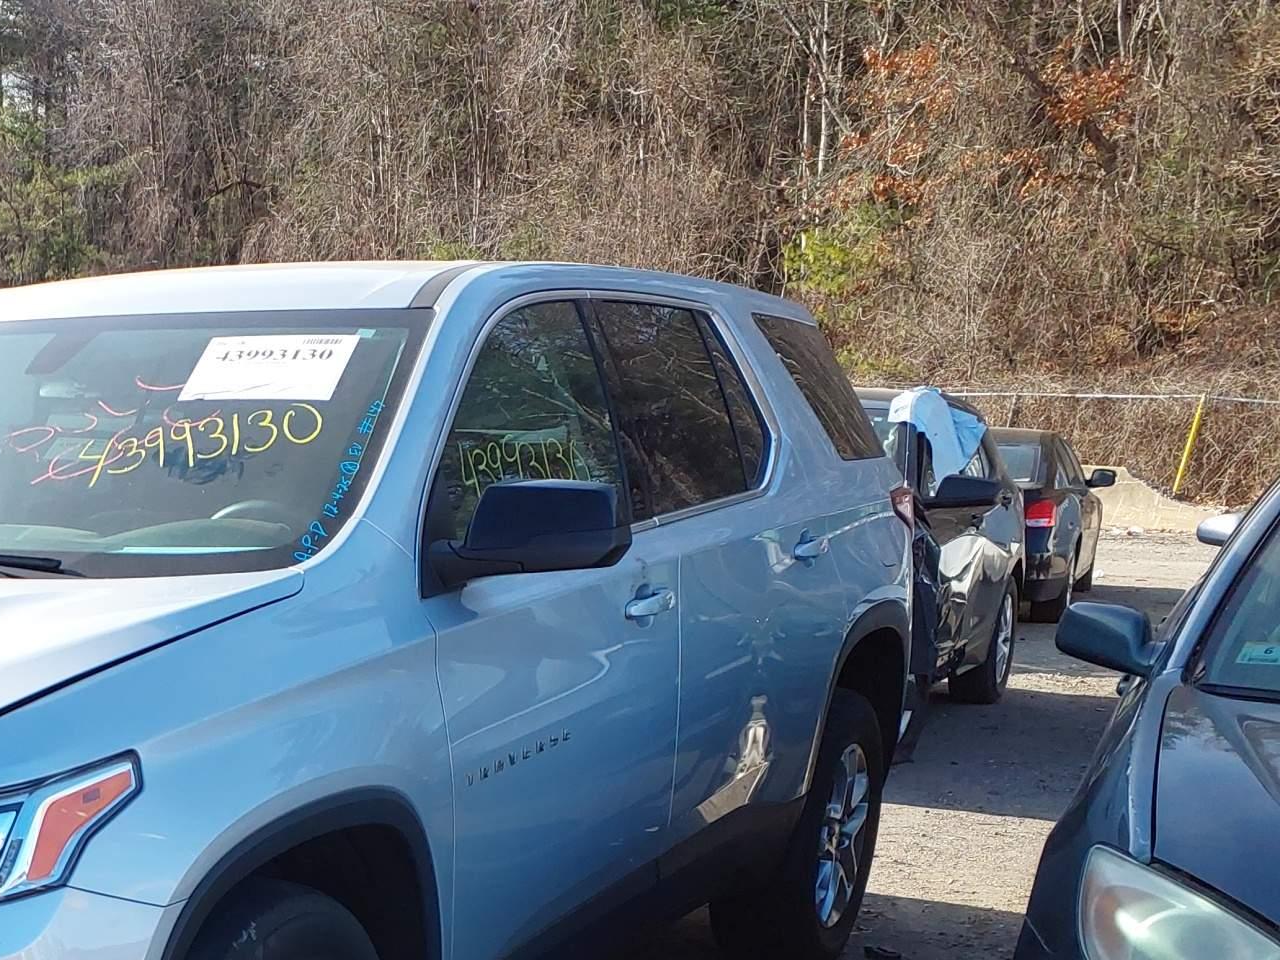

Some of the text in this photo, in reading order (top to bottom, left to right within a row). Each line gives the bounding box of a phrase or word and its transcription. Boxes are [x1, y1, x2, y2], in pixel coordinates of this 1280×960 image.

[215, 348, 334, 361] 43993130
[78, 402, 324, 488] 43993130
[1263, 646, 1276, 655] 6
